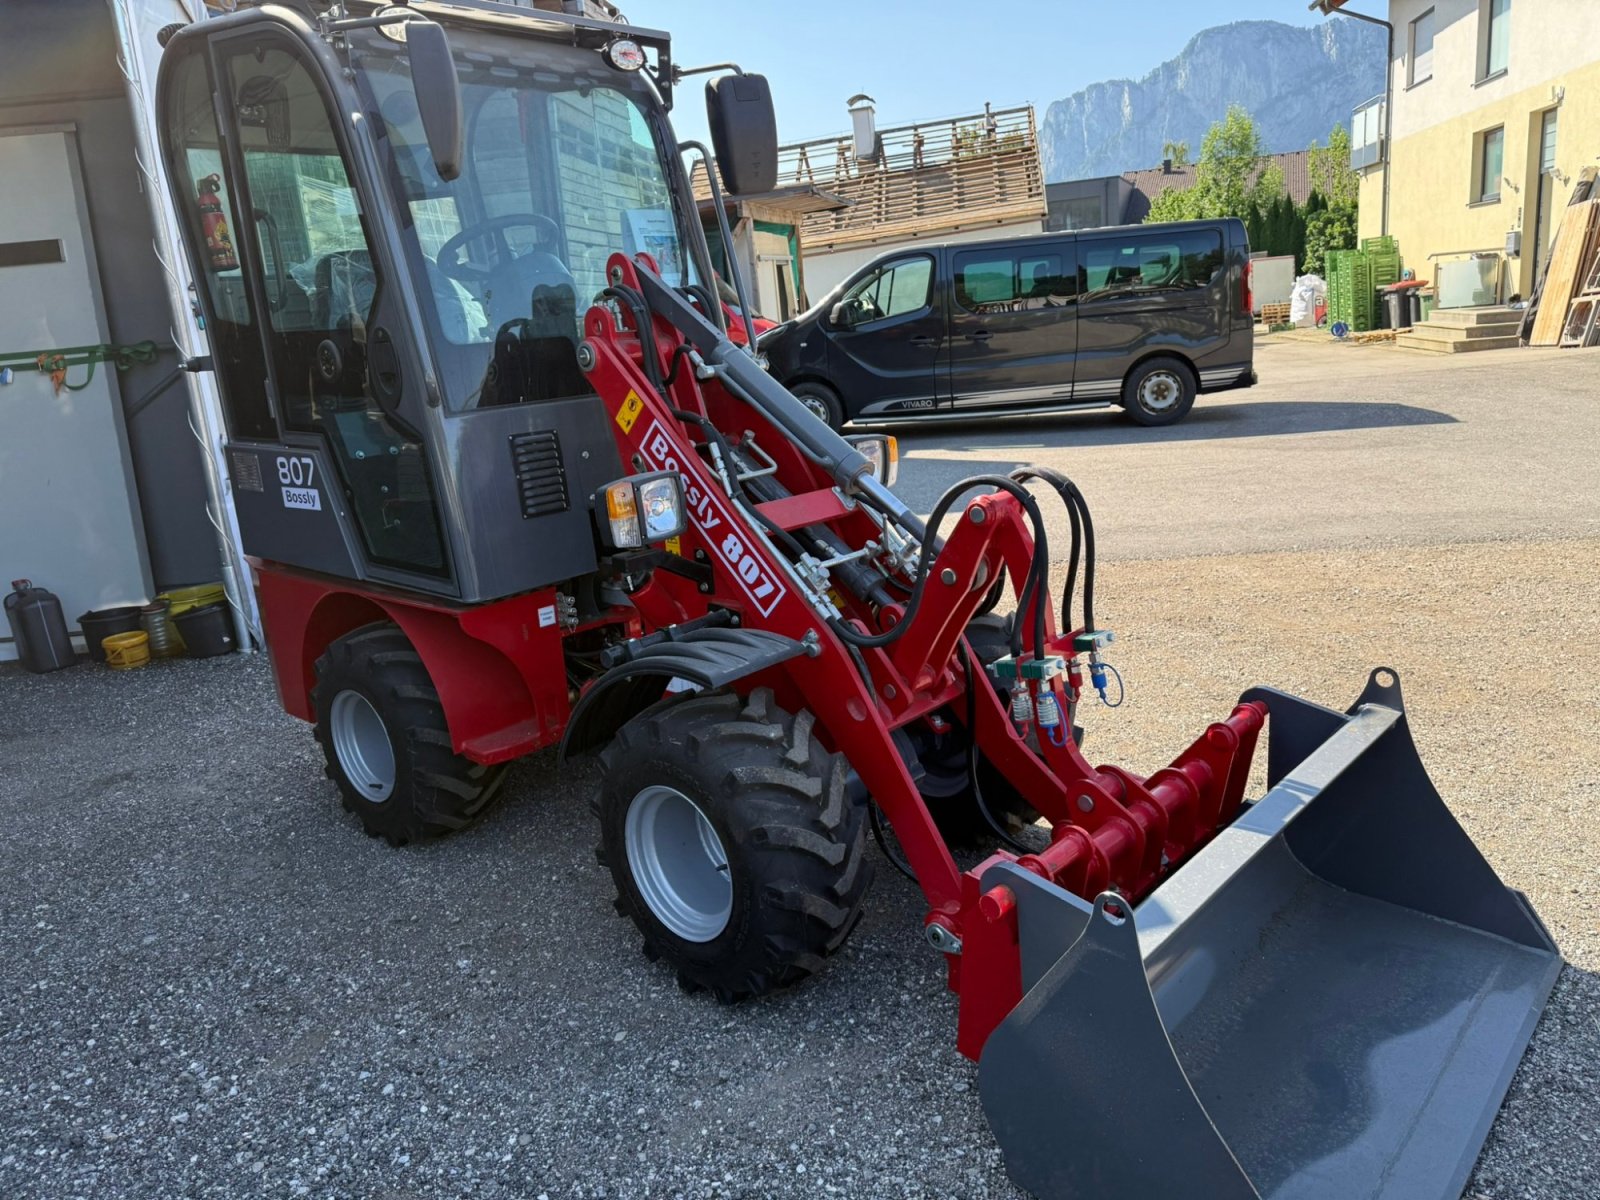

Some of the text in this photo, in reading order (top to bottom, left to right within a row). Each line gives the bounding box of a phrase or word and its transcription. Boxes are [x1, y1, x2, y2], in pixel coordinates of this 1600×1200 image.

[902, 400, 933, 409] VIVARO
[276, 456, 314, 486] 807
[285, 490, 316, 507] Bossly
[650, 433, 775, 599] Bossly 807
